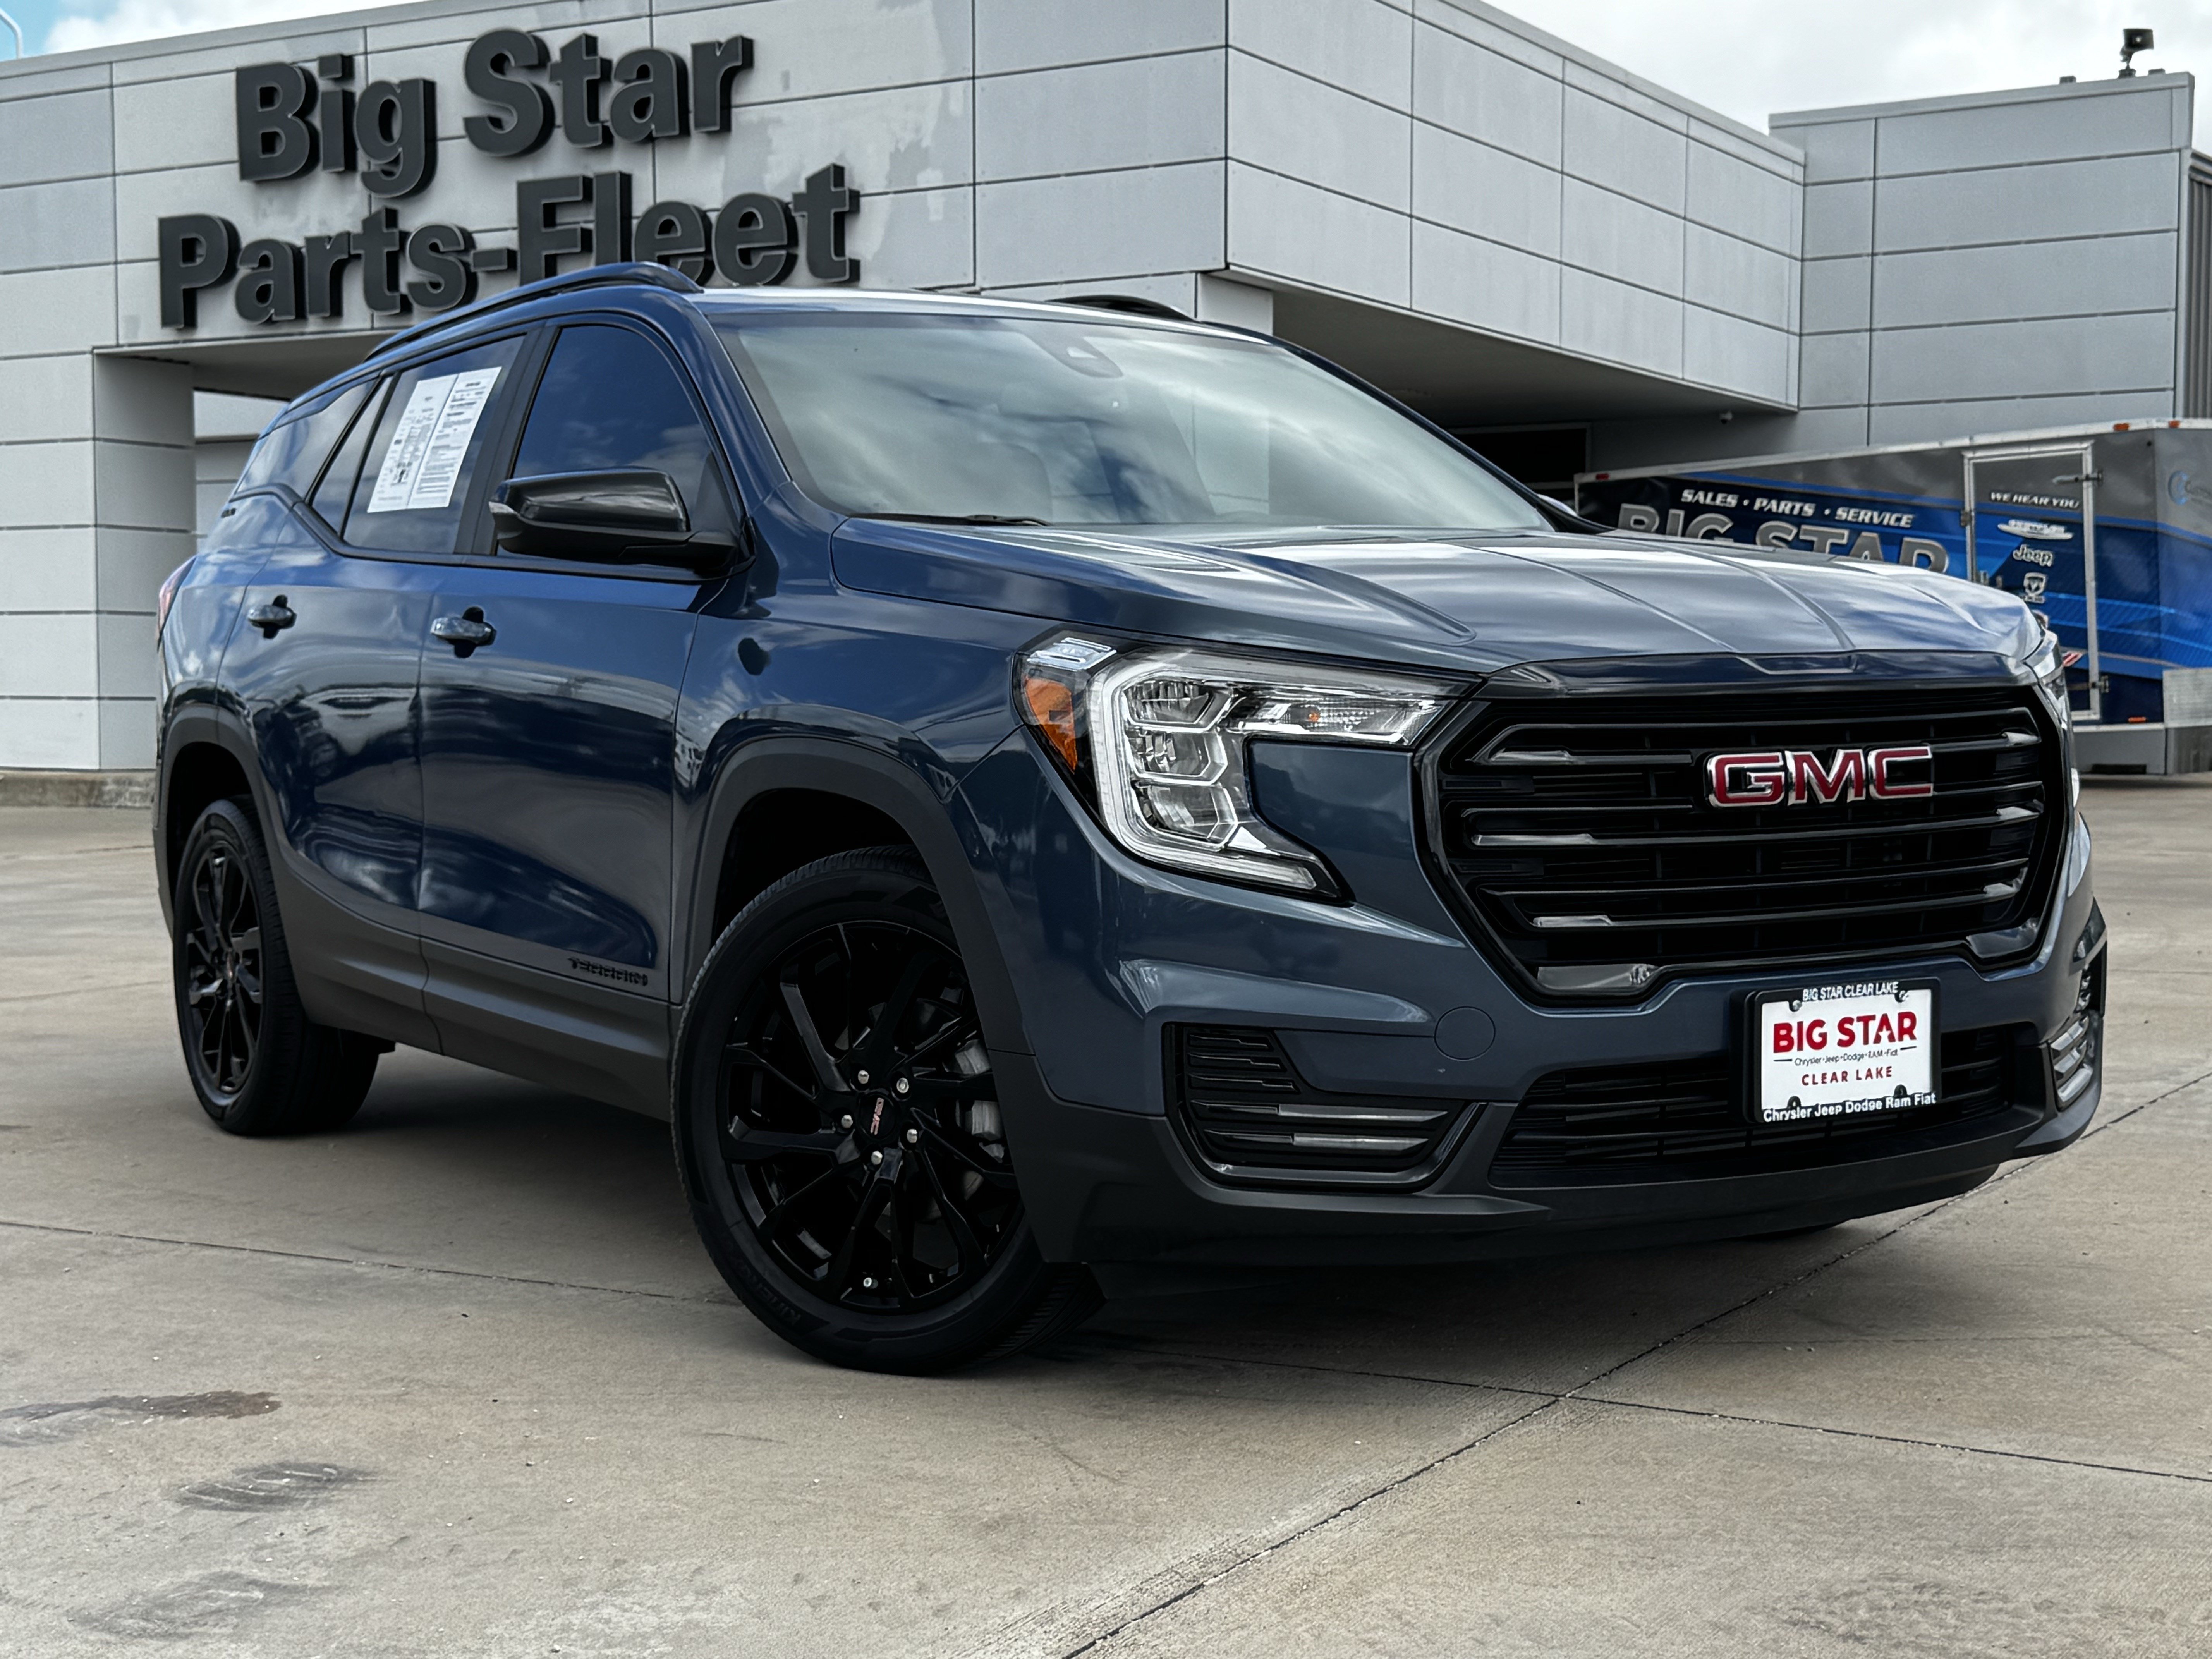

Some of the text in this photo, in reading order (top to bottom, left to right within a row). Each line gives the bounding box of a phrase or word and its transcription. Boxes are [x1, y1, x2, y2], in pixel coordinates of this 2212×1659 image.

[236, 28, 754, 197] Big Star
[158, 163, 860, 328] Parts-Fleet
[1681, 489, 1915, 528] SALES PARTS SERVICE
[2052, 498, 2079, 508] YOU
[2013, 544, 2053, 567] Jeep
[1707, 746, 1934, 808] GMC
[1802, 982, 1898, 1001] BIG STAR CLEAR LAKE
[1773, 1012, 1917, 1054] BIG STAR
[1802, 1065, 1893, 1086] CLEAR LAKE
[1763, 1091, 1937, 1123] Chrysler Jeep Dodge Ram Fiat
